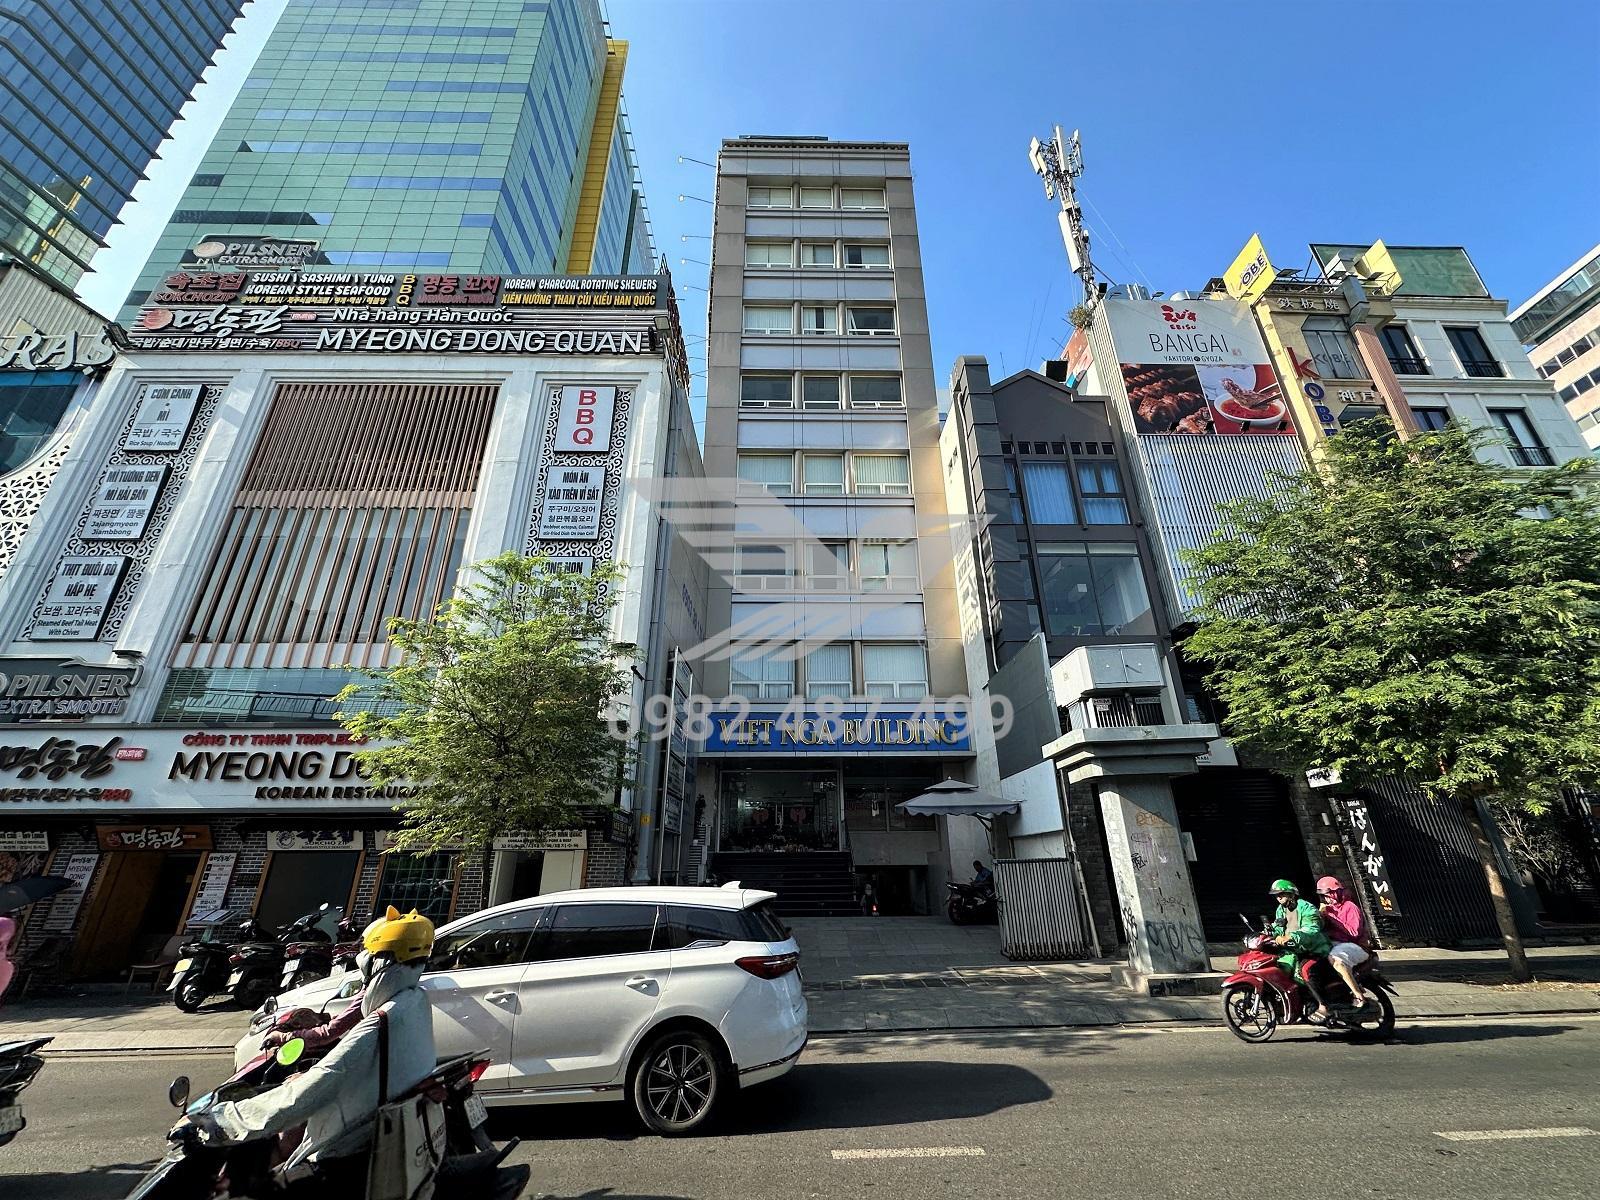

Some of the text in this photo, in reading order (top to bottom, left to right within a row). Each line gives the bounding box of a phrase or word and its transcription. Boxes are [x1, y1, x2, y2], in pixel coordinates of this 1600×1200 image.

[225, 243, 312, 257] PILSNER
[218, 256, 259, 264] EXTRA
[165, 272, 247, 290] 속초집
[252, 273, 290, 283] SUSHI
[300, 274, 351, 284] SASHIMI
[363, 274, 395, 284] TUNA
[423, 275, 500, 294] 명동 꼬치
[504, 279, 658, 291] KOREAN CHARCOAL ROTATING SKEWERS
[245, 285, 391, 296] KOREAN STYLE SEAFOOD
[395, 274, 416, 305] BBQ
[553, 294, 576, 305] THAN
[332, 306, 370, 321] Nhà
[375, 306, 421, 324] hàng
[426, 307, 461, 322] Hàn
[467, 306, 513, 322] Quốc
[315, 327, 643, 353] MYEONG DONG QUAN
[1148, 333, 1230, 353] BANGAI
[572, 389, 597, 445] BBQ
[131, 428, 153, 438] 국밥
[161, 428, 182, 438] 국수
[61, 563, 83, 579] THỊT
[84, 583, 99, 600] HẸ
[64, 605, 103, 617] 꼬리수육
[36, 619, 61, 627] Steamed
[61, 619, 75, 627] Beef
[84, 619, 98, 627] Meat
[48, 628, 80, 636] With Chives
[5, 674, 129, 697] PILSNER
[0, 700, 122, 714] EXTRA SMOOTH
[780, 718, 836, 745] NGA
[841, 718, 959, 745] BUILDING
[229, 735, 248, 746] TY
[250, 734, 292, 746] TNHH
[168, 751, 325, 780] MYEONG
[254, 786, 327, 799] KOREAN
[1350, 807, 1389, 894] ばんがい
